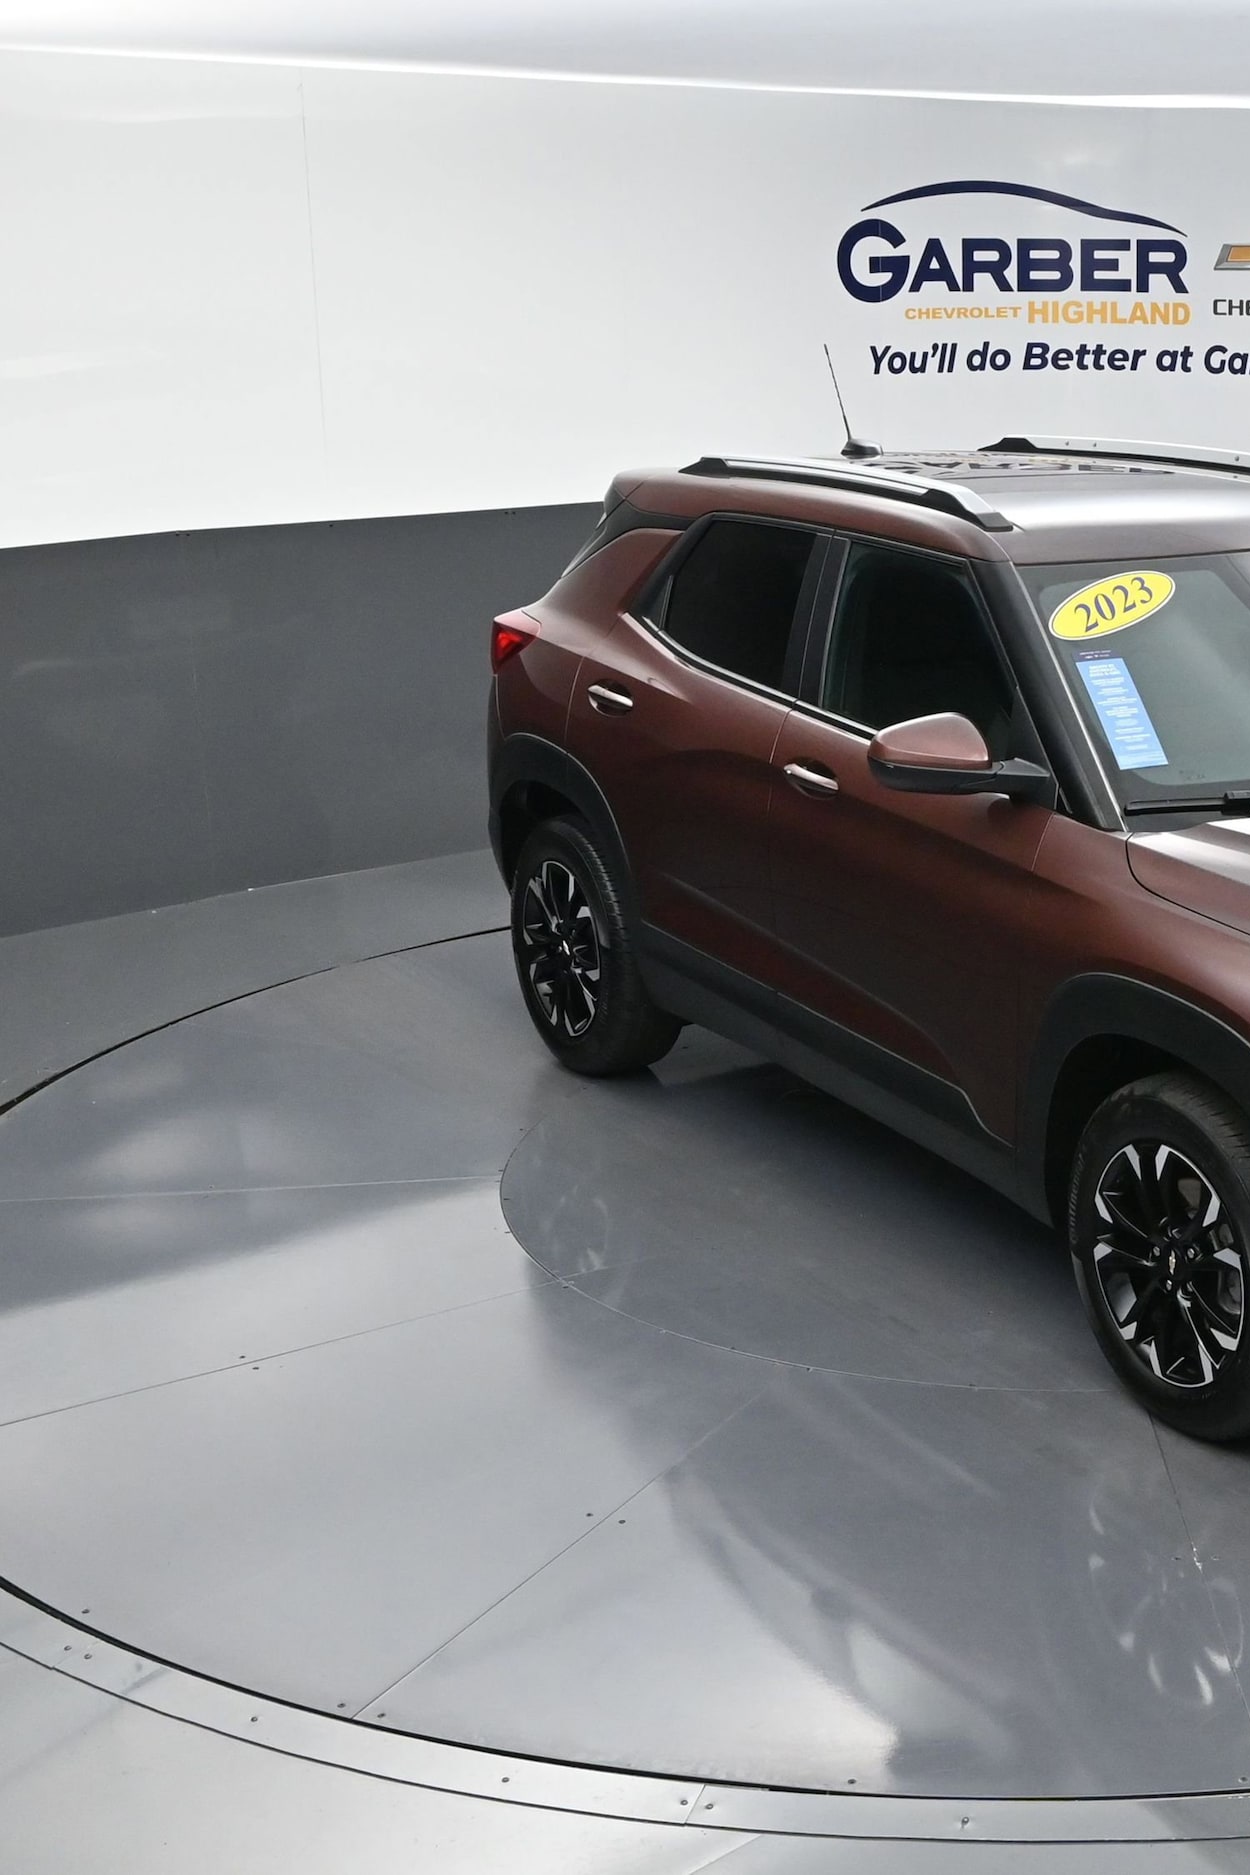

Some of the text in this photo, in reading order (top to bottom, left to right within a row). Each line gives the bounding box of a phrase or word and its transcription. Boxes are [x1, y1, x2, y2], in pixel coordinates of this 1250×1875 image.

[836, 218, 1190, 303] GARBER
[904, 300, 1191, 326] CHEVROLET HIGHLAND
[869, 342, 958, 375] You'll
[966, 340, 1012, 372] do
[1022, 342, 1147, 372] Better
[1155, 345, 1194, 373] at
[1073, 576, 1154, 633] 2023
